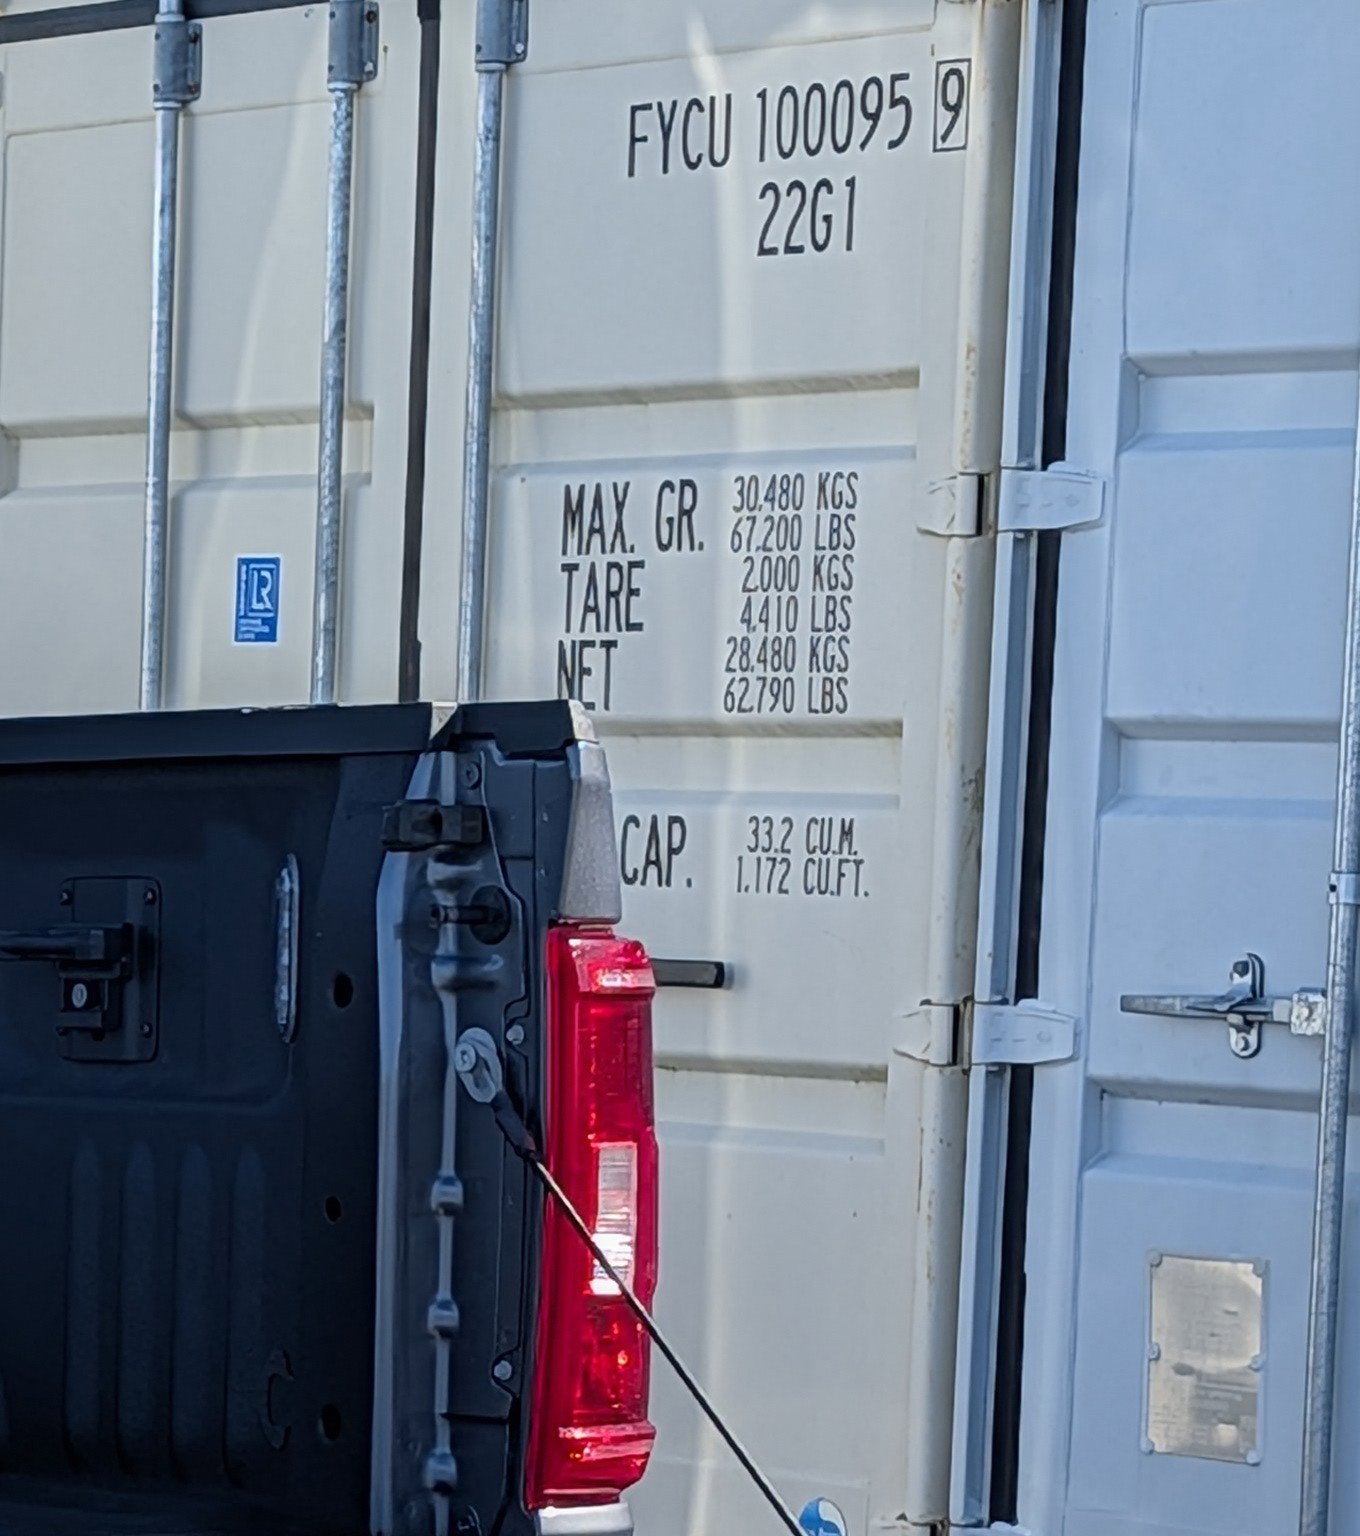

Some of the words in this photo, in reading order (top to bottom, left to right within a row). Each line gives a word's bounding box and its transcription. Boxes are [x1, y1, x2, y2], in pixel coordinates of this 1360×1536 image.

[628, 93, 732, 177] FYCU
[755, 73, 913, 162] 100095
[940, 68, 965, 144] 9
[757, 176, 857, 257] 22G1
[561, 481, 635, 556] MAX.
[656, 479, 704, 552] GR.
[733, 472, 805, 513] 30.480
[816, 471, 859, 511] KGS
[730, 513, 803, 553] 67.200
[814, 513, 856, 551] LBS
[560, 559, 645, 633] TARE
[811, 554, 855, 592] KGS
[740, 595, 799, 634] 4.410
[810, 595, 853, 633] LBS
[557, 639, 618, 711] NET
[724, 635, 797, 673] 28.480
[808, 635, 851, 673] KGS
[807, 676, 849, 714] LBS
[621, 814, 692, 888] CAP.
[736, 856, 791, 895] 1.172
